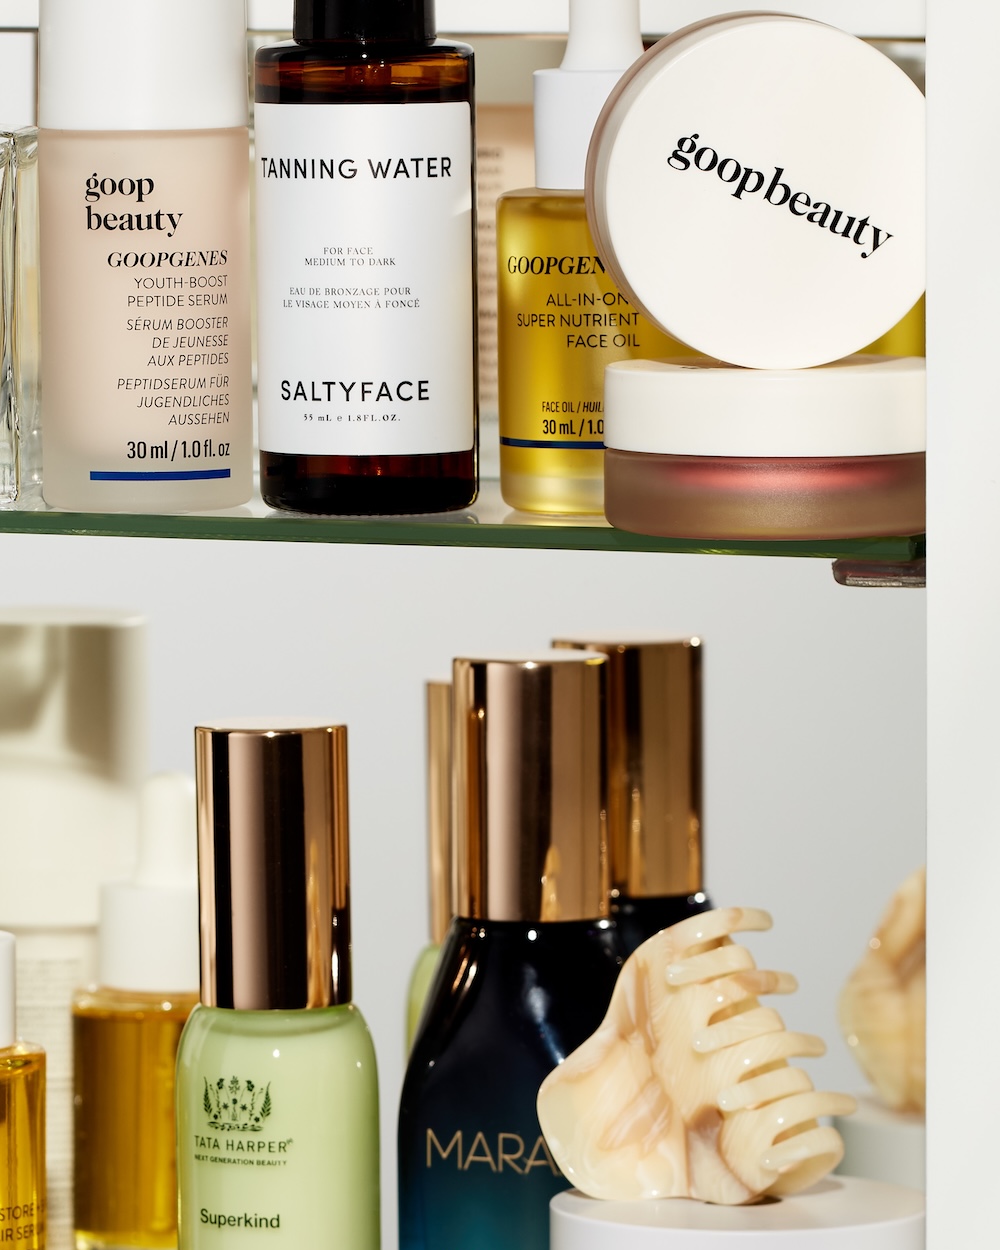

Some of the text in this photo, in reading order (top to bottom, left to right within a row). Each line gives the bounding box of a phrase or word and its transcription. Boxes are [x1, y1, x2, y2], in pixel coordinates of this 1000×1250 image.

[261, 157, 452, 179] TANNING WATER
[85, 172, 155, 203] goop
[85, 205, 183, 238] beauty
[323, 247, 373, 255] FOR FACE
[107, 250, 228, 268] GOOPGENES
[304, 257, 396, 267] MEDIUM TO DARK
[134, 275, 228, 289] YOUTH-BOOST
[289, 287, 411, 296] EAU DE BRONZAGE POUR
[127, 293, 228, 307] PEPTIDE SERUM
[283, 299, 293, 308] LE
[296, 300, 329, 308] VISAGE
[333, 300, 371, 308] MOYEN
[385, 298, 420, 308] FONCÉ
[546, 292, 629, 307] ALL-IN-ON
[126, 316, 228, 331] SÉRUM BOOSTER
[517, 313, 640, 327] SUPER NUTRIENT
[152, 334, 229, 349] DE JEUNESSE
[567, 334, 641, 349] FACE OIL
[147, 352, 229, 367] AUX PEPTIDES
[117, 374, 229, 390] PEPTIDSERUM FÜR
[280, 380, 430, 402] SALTYFACE
[137, 393, 229, 408] JUGENDLICHES
[168, 411, 230, 426] AUSSEHEN
[194, 1135, 220, 1150] TATA
[426, 1127, 559, 1176] MARA
[210, 1156, 254, 1165] GENERATION
[256, 1158, 287, 1166] BEAUTY
[200, 1208, 280, 1228] Superkind
